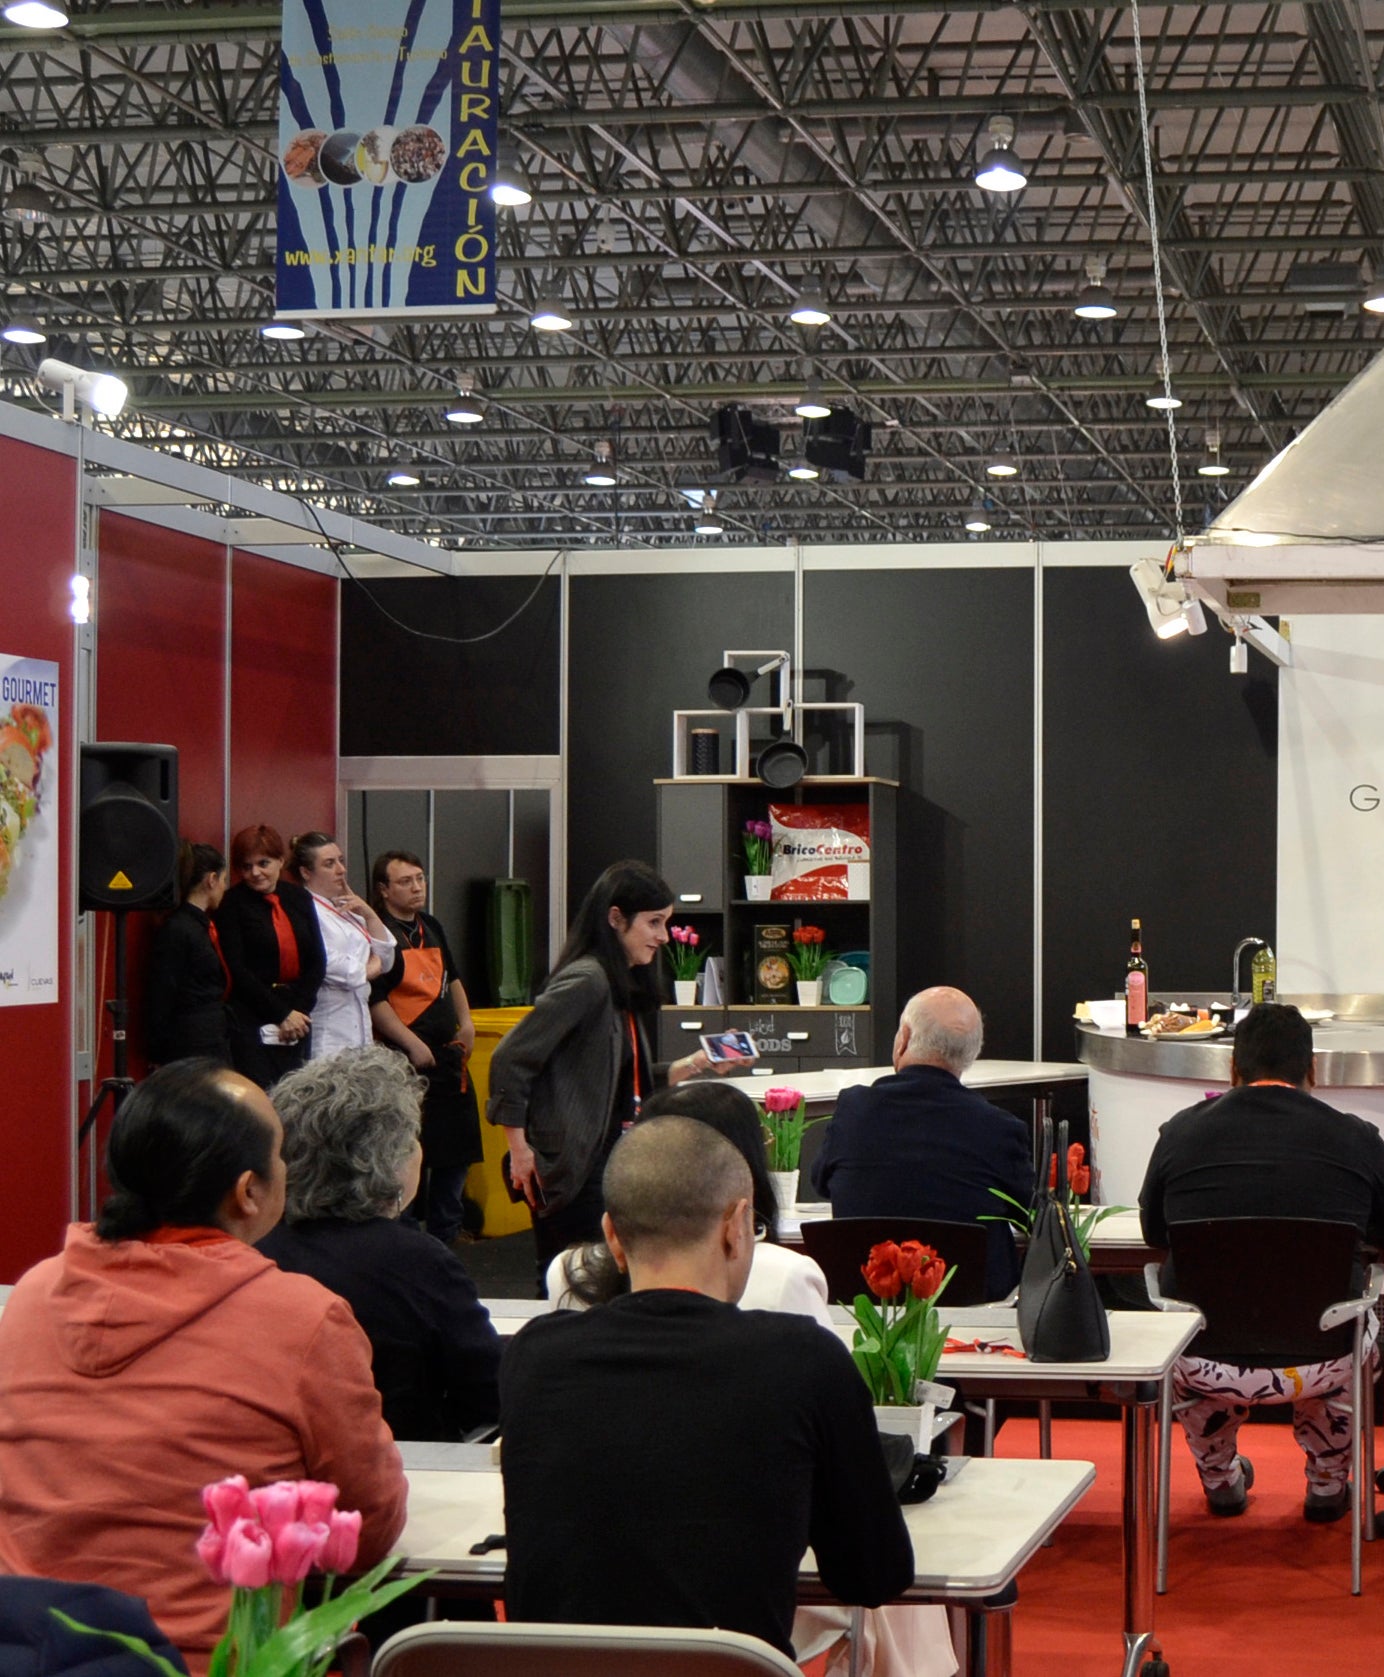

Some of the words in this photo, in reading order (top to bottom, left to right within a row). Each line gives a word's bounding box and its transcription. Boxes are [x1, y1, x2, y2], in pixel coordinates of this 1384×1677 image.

[2, 676, 56, 707] GOURMET
[783, 843, 863, 855] BricoCentro
[758, 1038, 792, 1052] ODS
